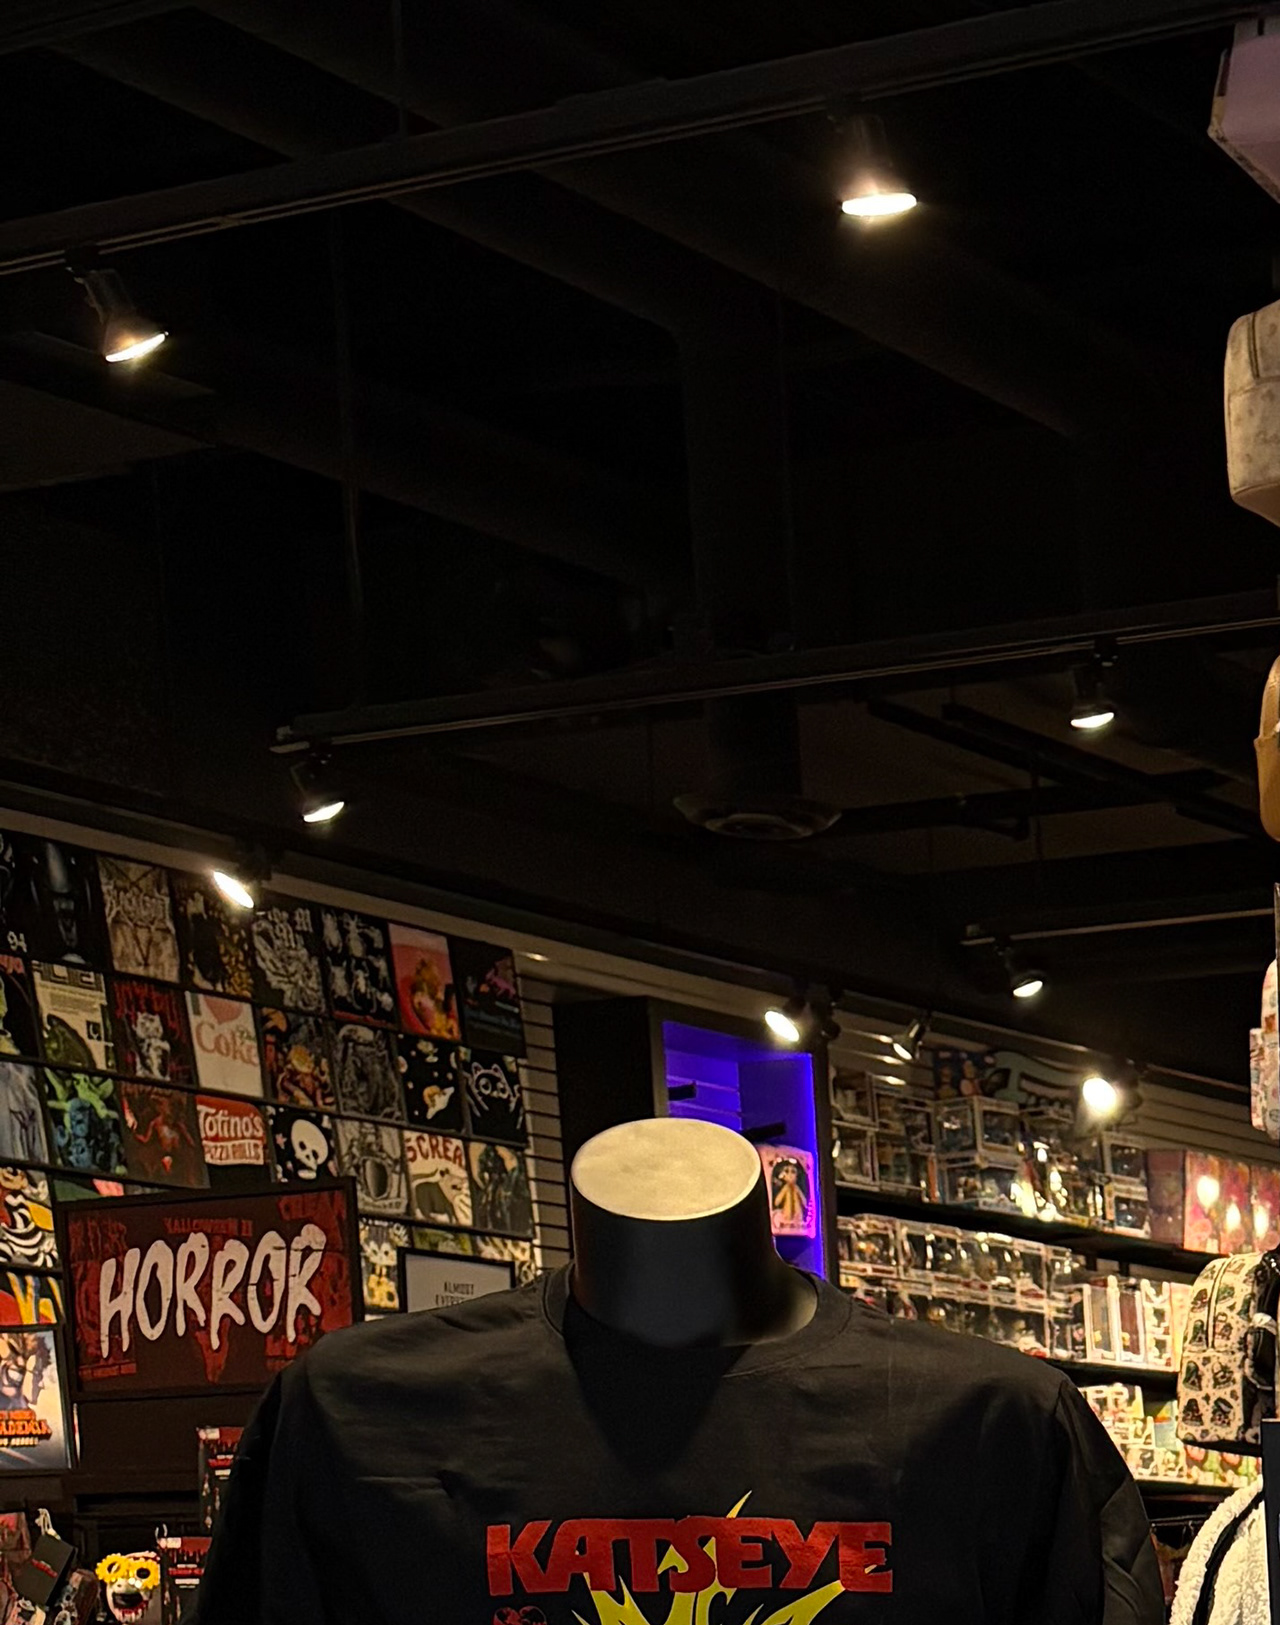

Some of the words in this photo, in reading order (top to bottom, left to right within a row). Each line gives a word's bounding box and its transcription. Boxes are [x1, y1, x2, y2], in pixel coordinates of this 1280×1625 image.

[197, 1105, 264, 1139] Totino's
[100, 1220, 328, 1359] HORROR
[485, 1516, 894, 1597] KATSEYE
